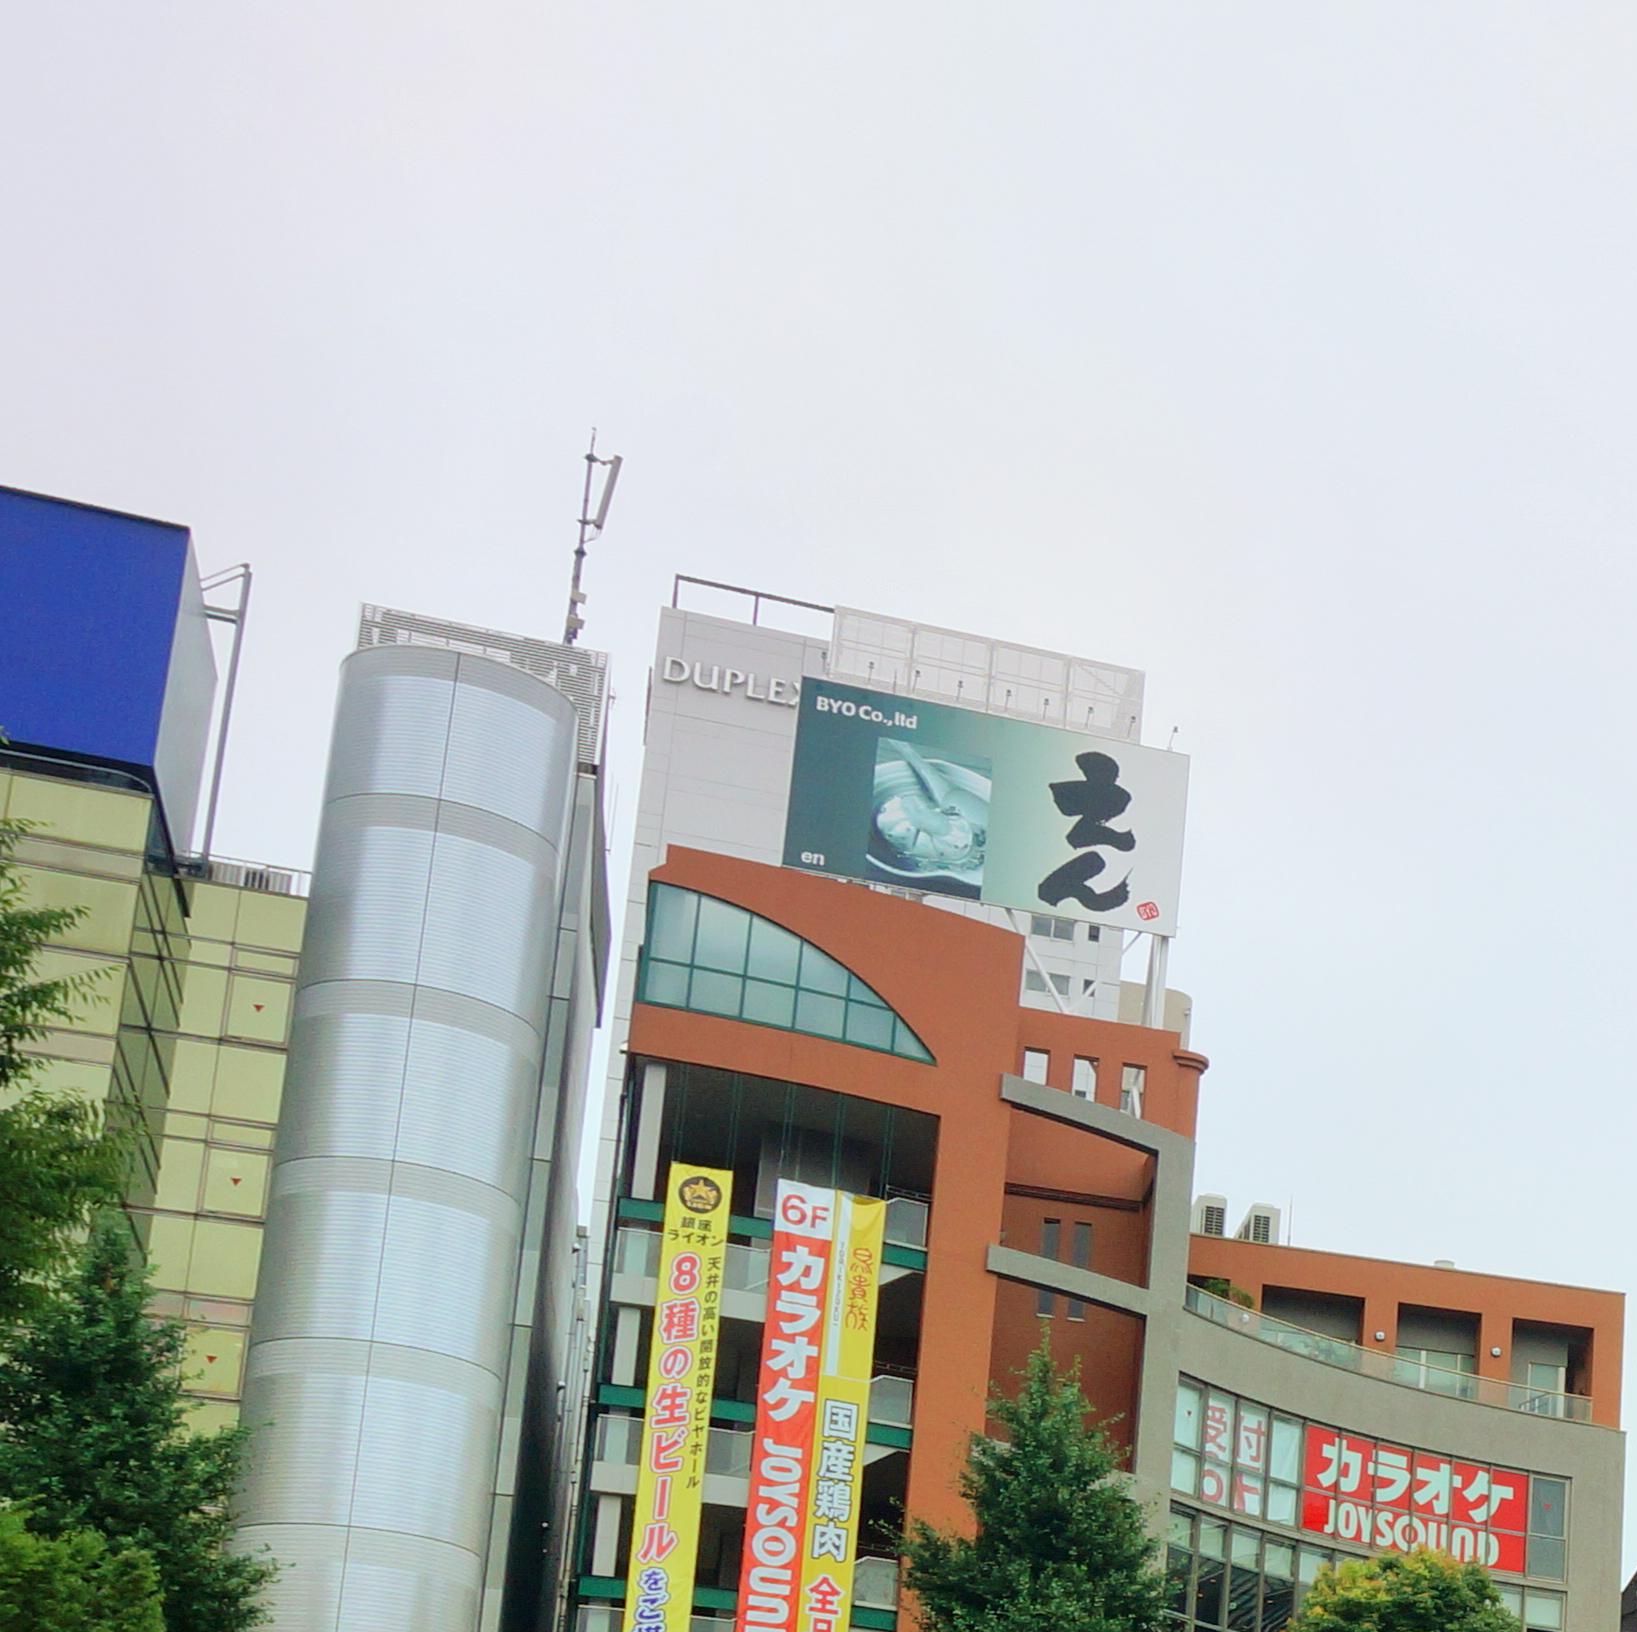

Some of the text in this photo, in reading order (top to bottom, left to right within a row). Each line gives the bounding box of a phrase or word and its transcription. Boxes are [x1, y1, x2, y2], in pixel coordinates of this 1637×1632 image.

[815, 695, 856, 717] BYO
[801, 851, 825, 867] en
[1038, 751, 1136, 912] えん
[668, 1229, 725, 1247] ライオン
[781, 1193, 830, 1230] 6F
[762, 1245, 826, 1422] カラオケ
[812, 1398, 860, 1562] 国産鶏肉
[1316, 1435, 1515, 1523] カラオケ
[1323, 1499, 1500, 1567] JOYSOUND
